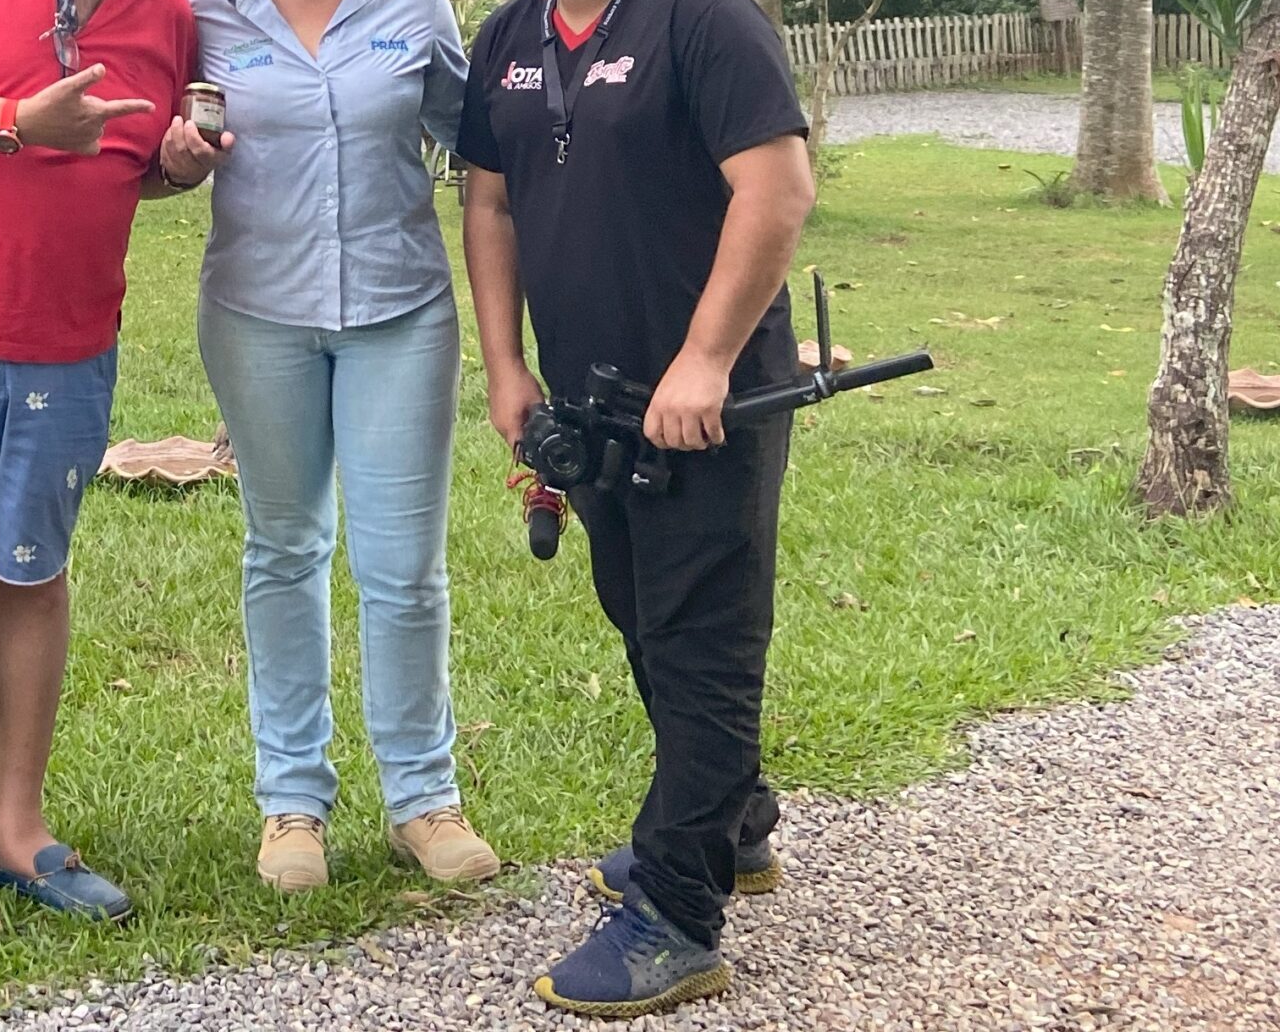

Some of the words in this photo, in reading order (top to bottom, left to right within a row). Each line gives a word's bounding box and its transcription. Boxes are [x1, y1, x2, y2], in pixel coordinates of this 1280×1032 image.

[370, 39, 409, 52] PRATA
[501, 61, 543, 88] JOTA
[513, 81, 543, 90] AMIGOS
